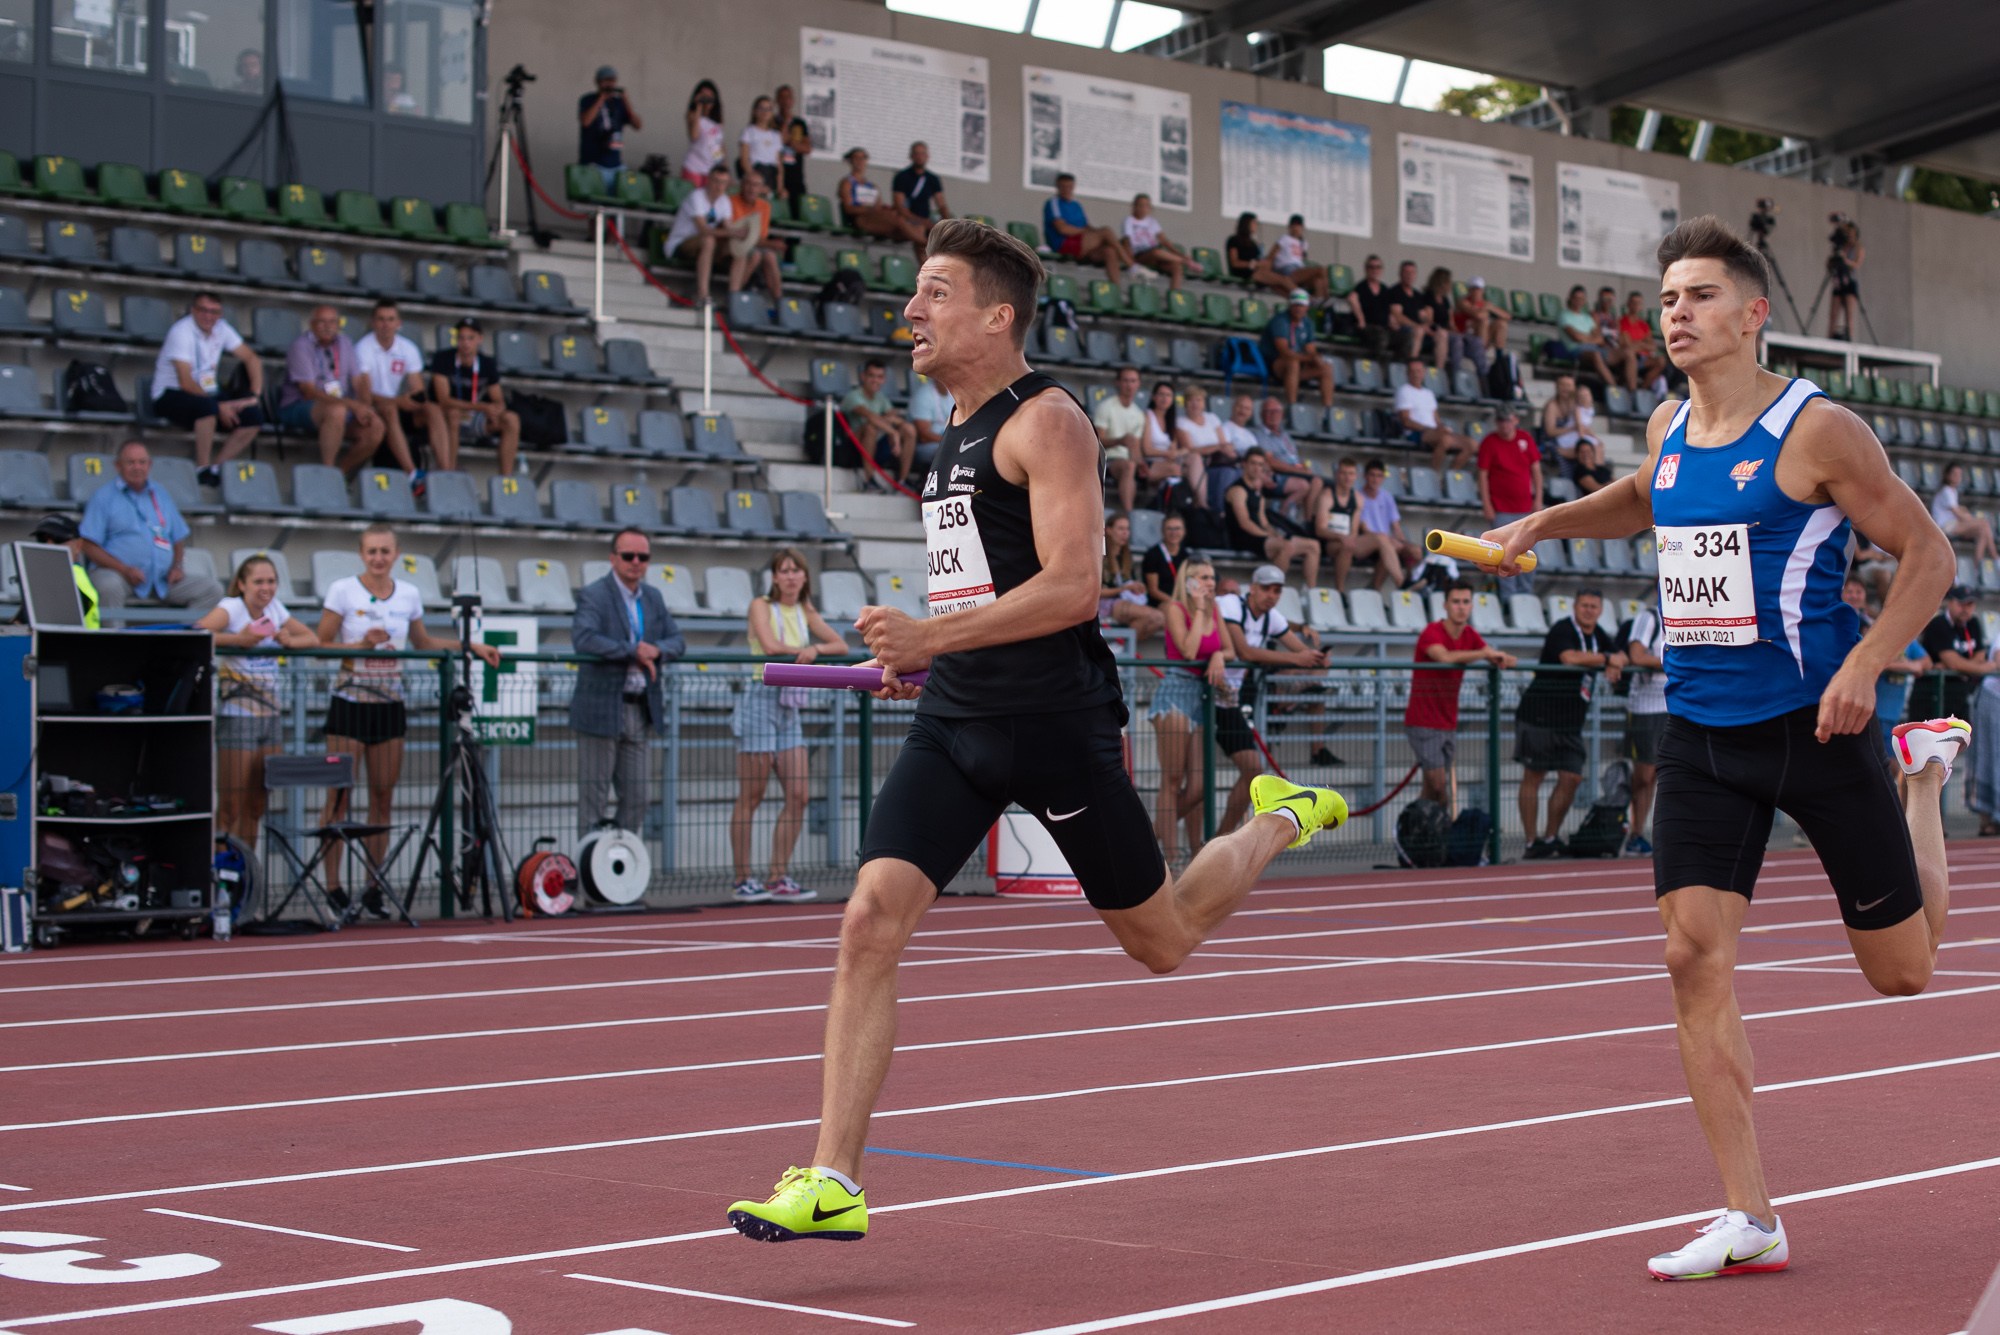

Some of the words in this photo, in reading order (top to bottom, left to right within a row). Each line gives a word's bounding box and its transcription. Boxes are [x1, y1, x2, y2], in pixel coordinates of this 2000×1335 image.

[937, 501, 969, 530] 258
[1693, 530, 1740, 557] 334
[1665, 576, 1730, 607] PAJĄK
[1668, 630, 1711, 642] SUWAŁKI
[1712, 631, 1735, 642] 2021
[482, 630, 517, 702] F
